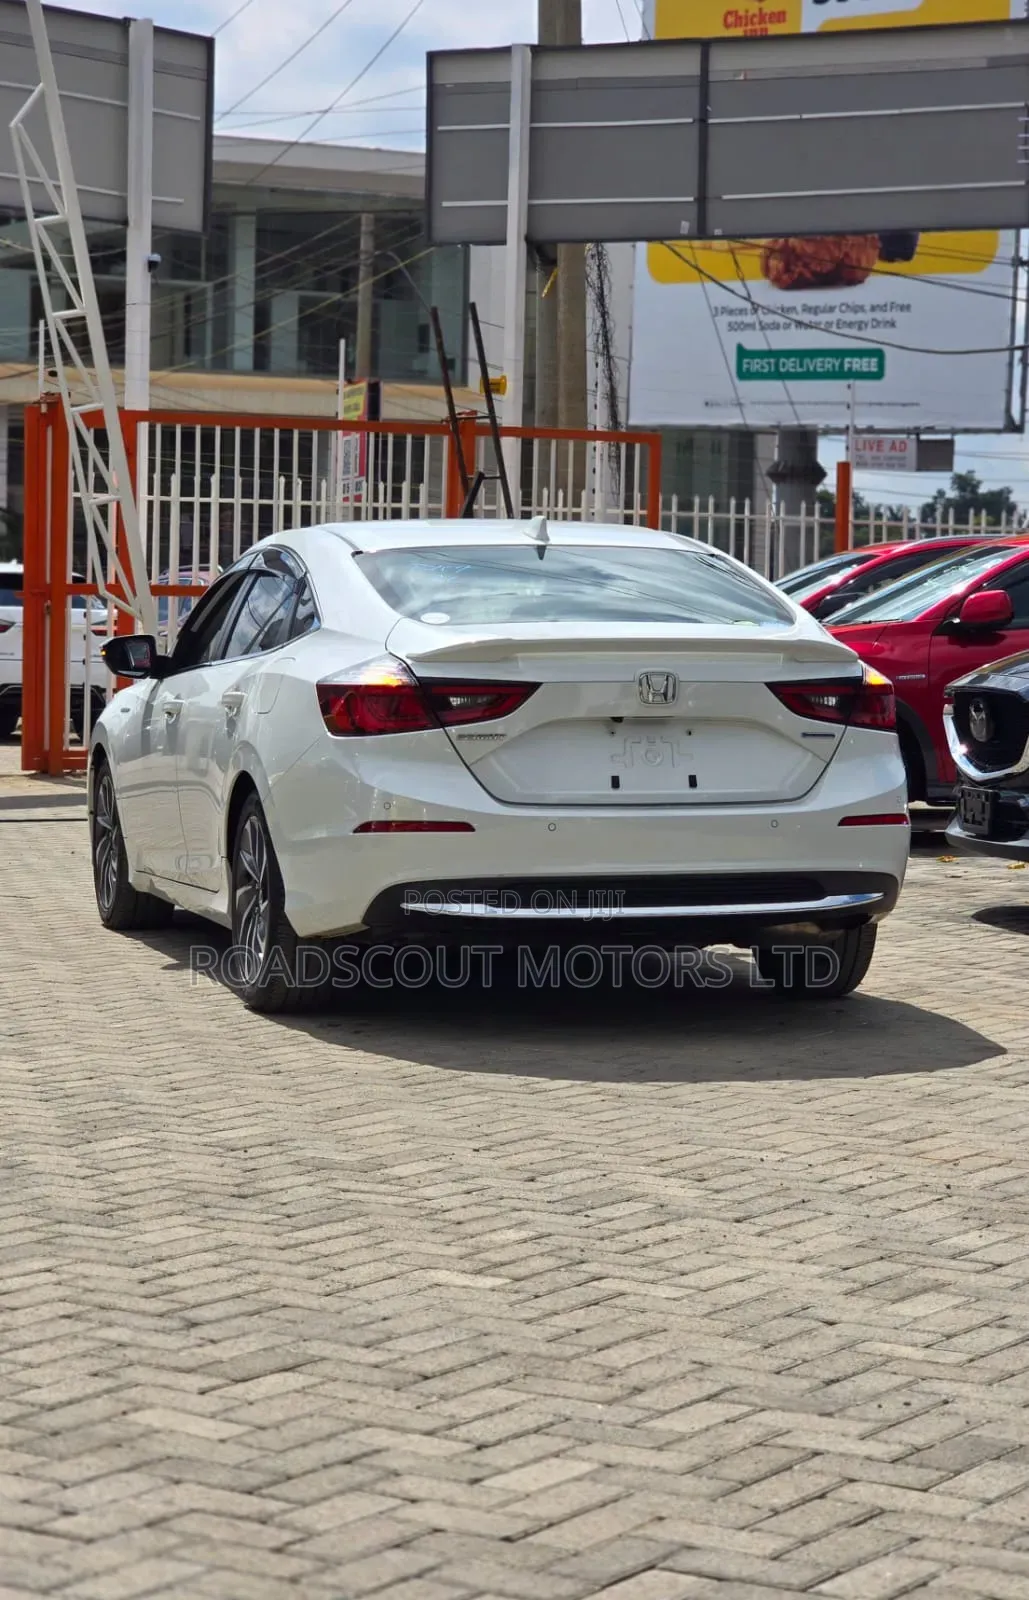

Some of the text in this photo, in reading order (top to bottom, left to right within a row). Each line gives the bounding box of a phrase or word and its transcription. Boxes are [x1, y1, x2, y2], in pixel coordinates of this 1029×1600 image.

[723, 8, 787, 30] Chicken
[801, 303, 837, 316] Regular
[870, 302, 888, 313] and
[890, 302, 912, 313] Free
[836, 318, 868, 331] Energy
[871, 317, 897, 329] Drink
[742, 356, 879, 373] FIRST DELIVERY FREE
[854, 438, 908, 453] LIVE AD
